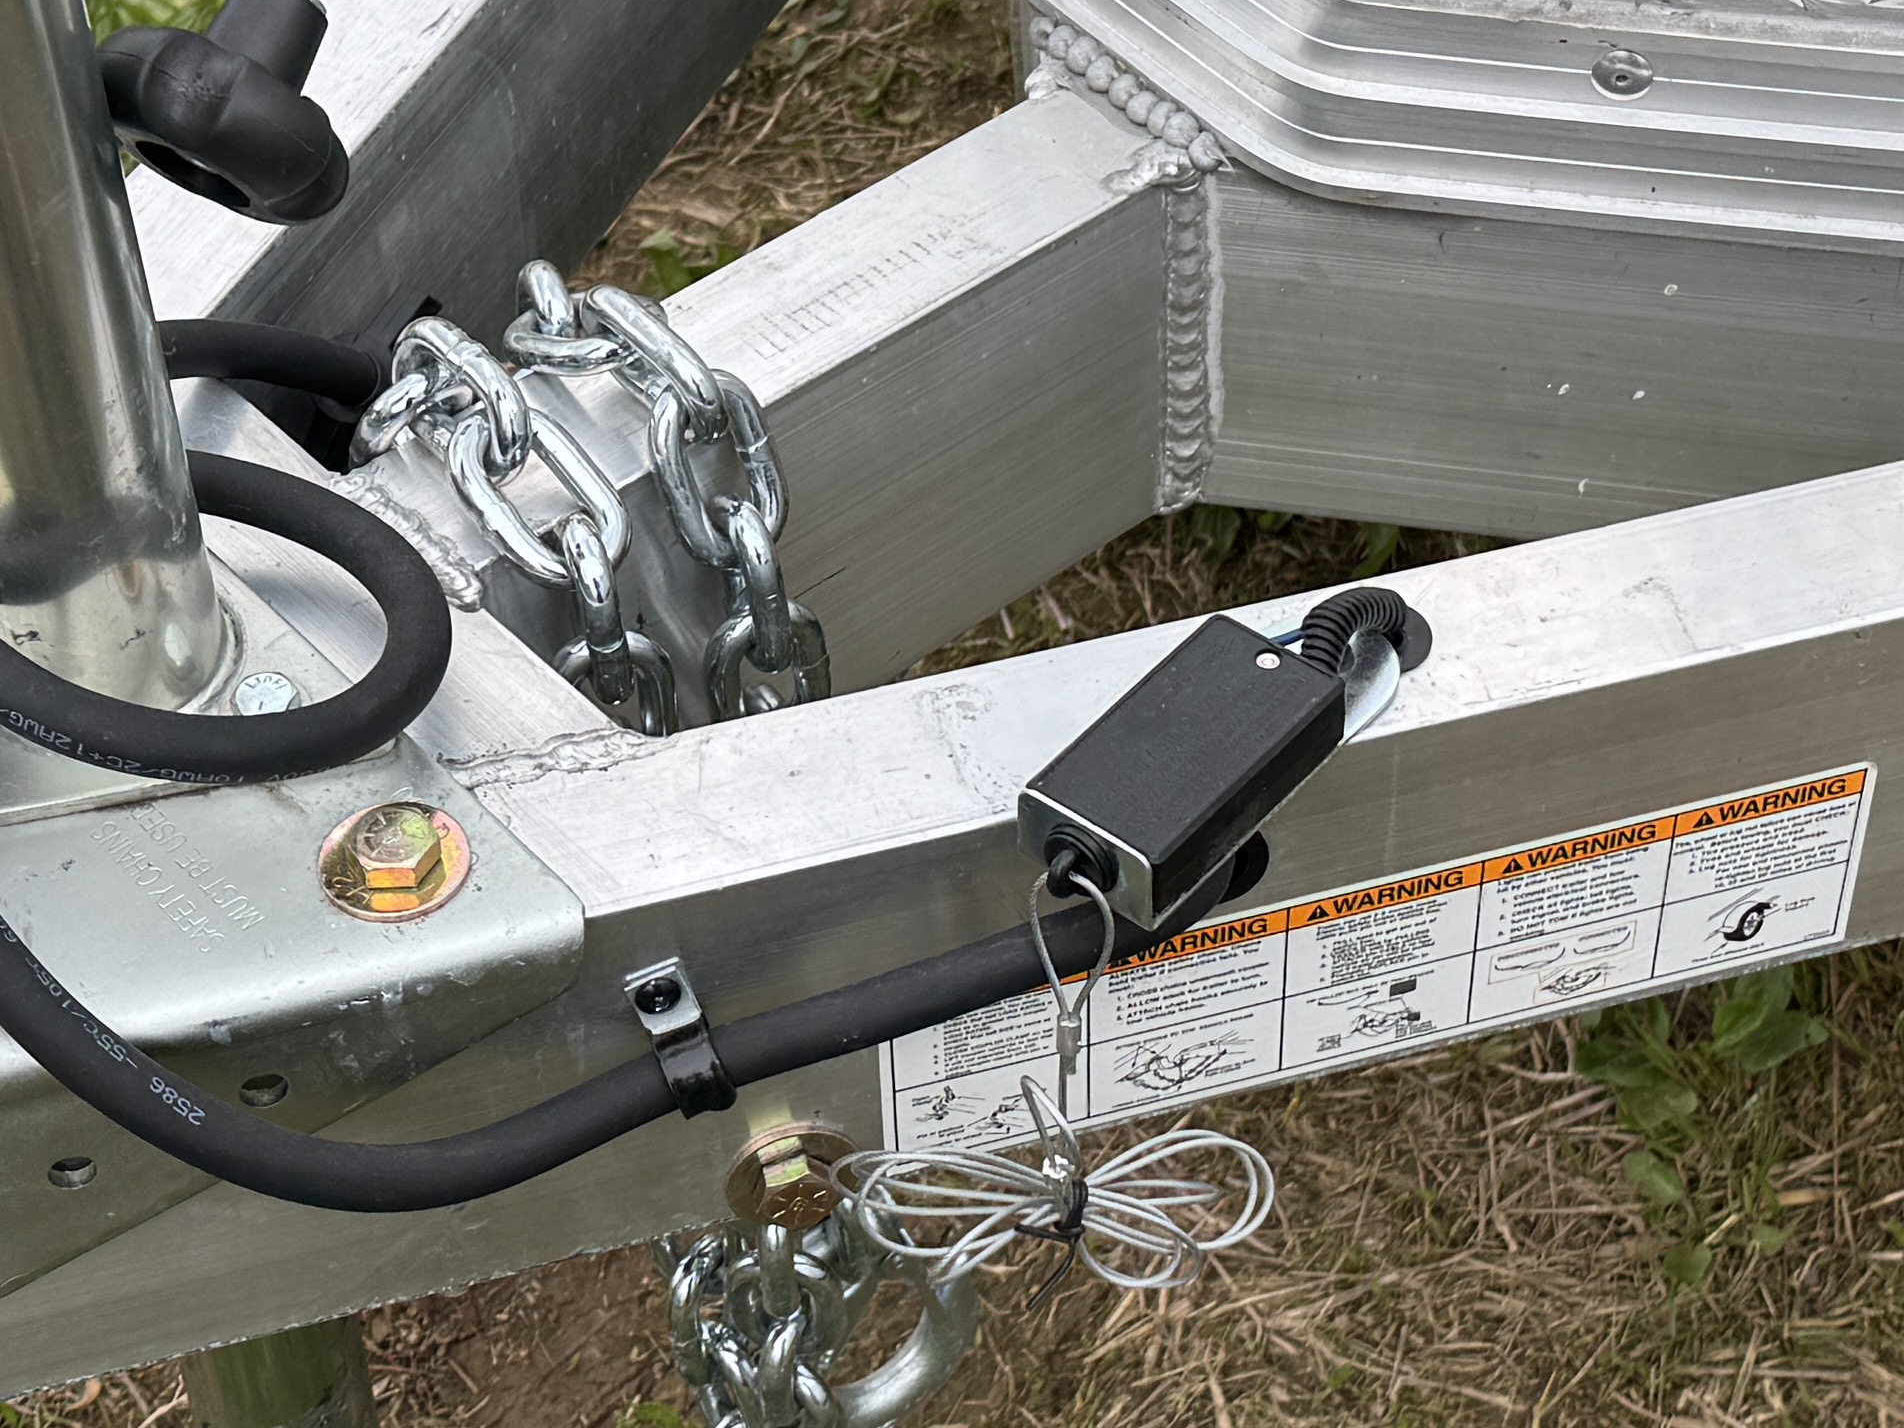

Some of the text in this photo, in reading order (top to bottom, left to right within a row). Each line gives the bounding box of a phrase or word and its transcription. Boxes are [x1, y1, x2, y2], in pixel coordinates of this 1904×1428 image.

[1718, 777, 1846, 822] WARNING
[174, 848, 215, 879] BE
[1526, 822, 1657, 868] WARNING
[89, 820, 225, 953] SAFETY CHAINS
[198, 876, 266, 930] MUST
[1332, 868, 1464, 915] WARNING
[1136, 915, 1268, 962] WARNING
[149, 1075, 207, 1126] 2586
